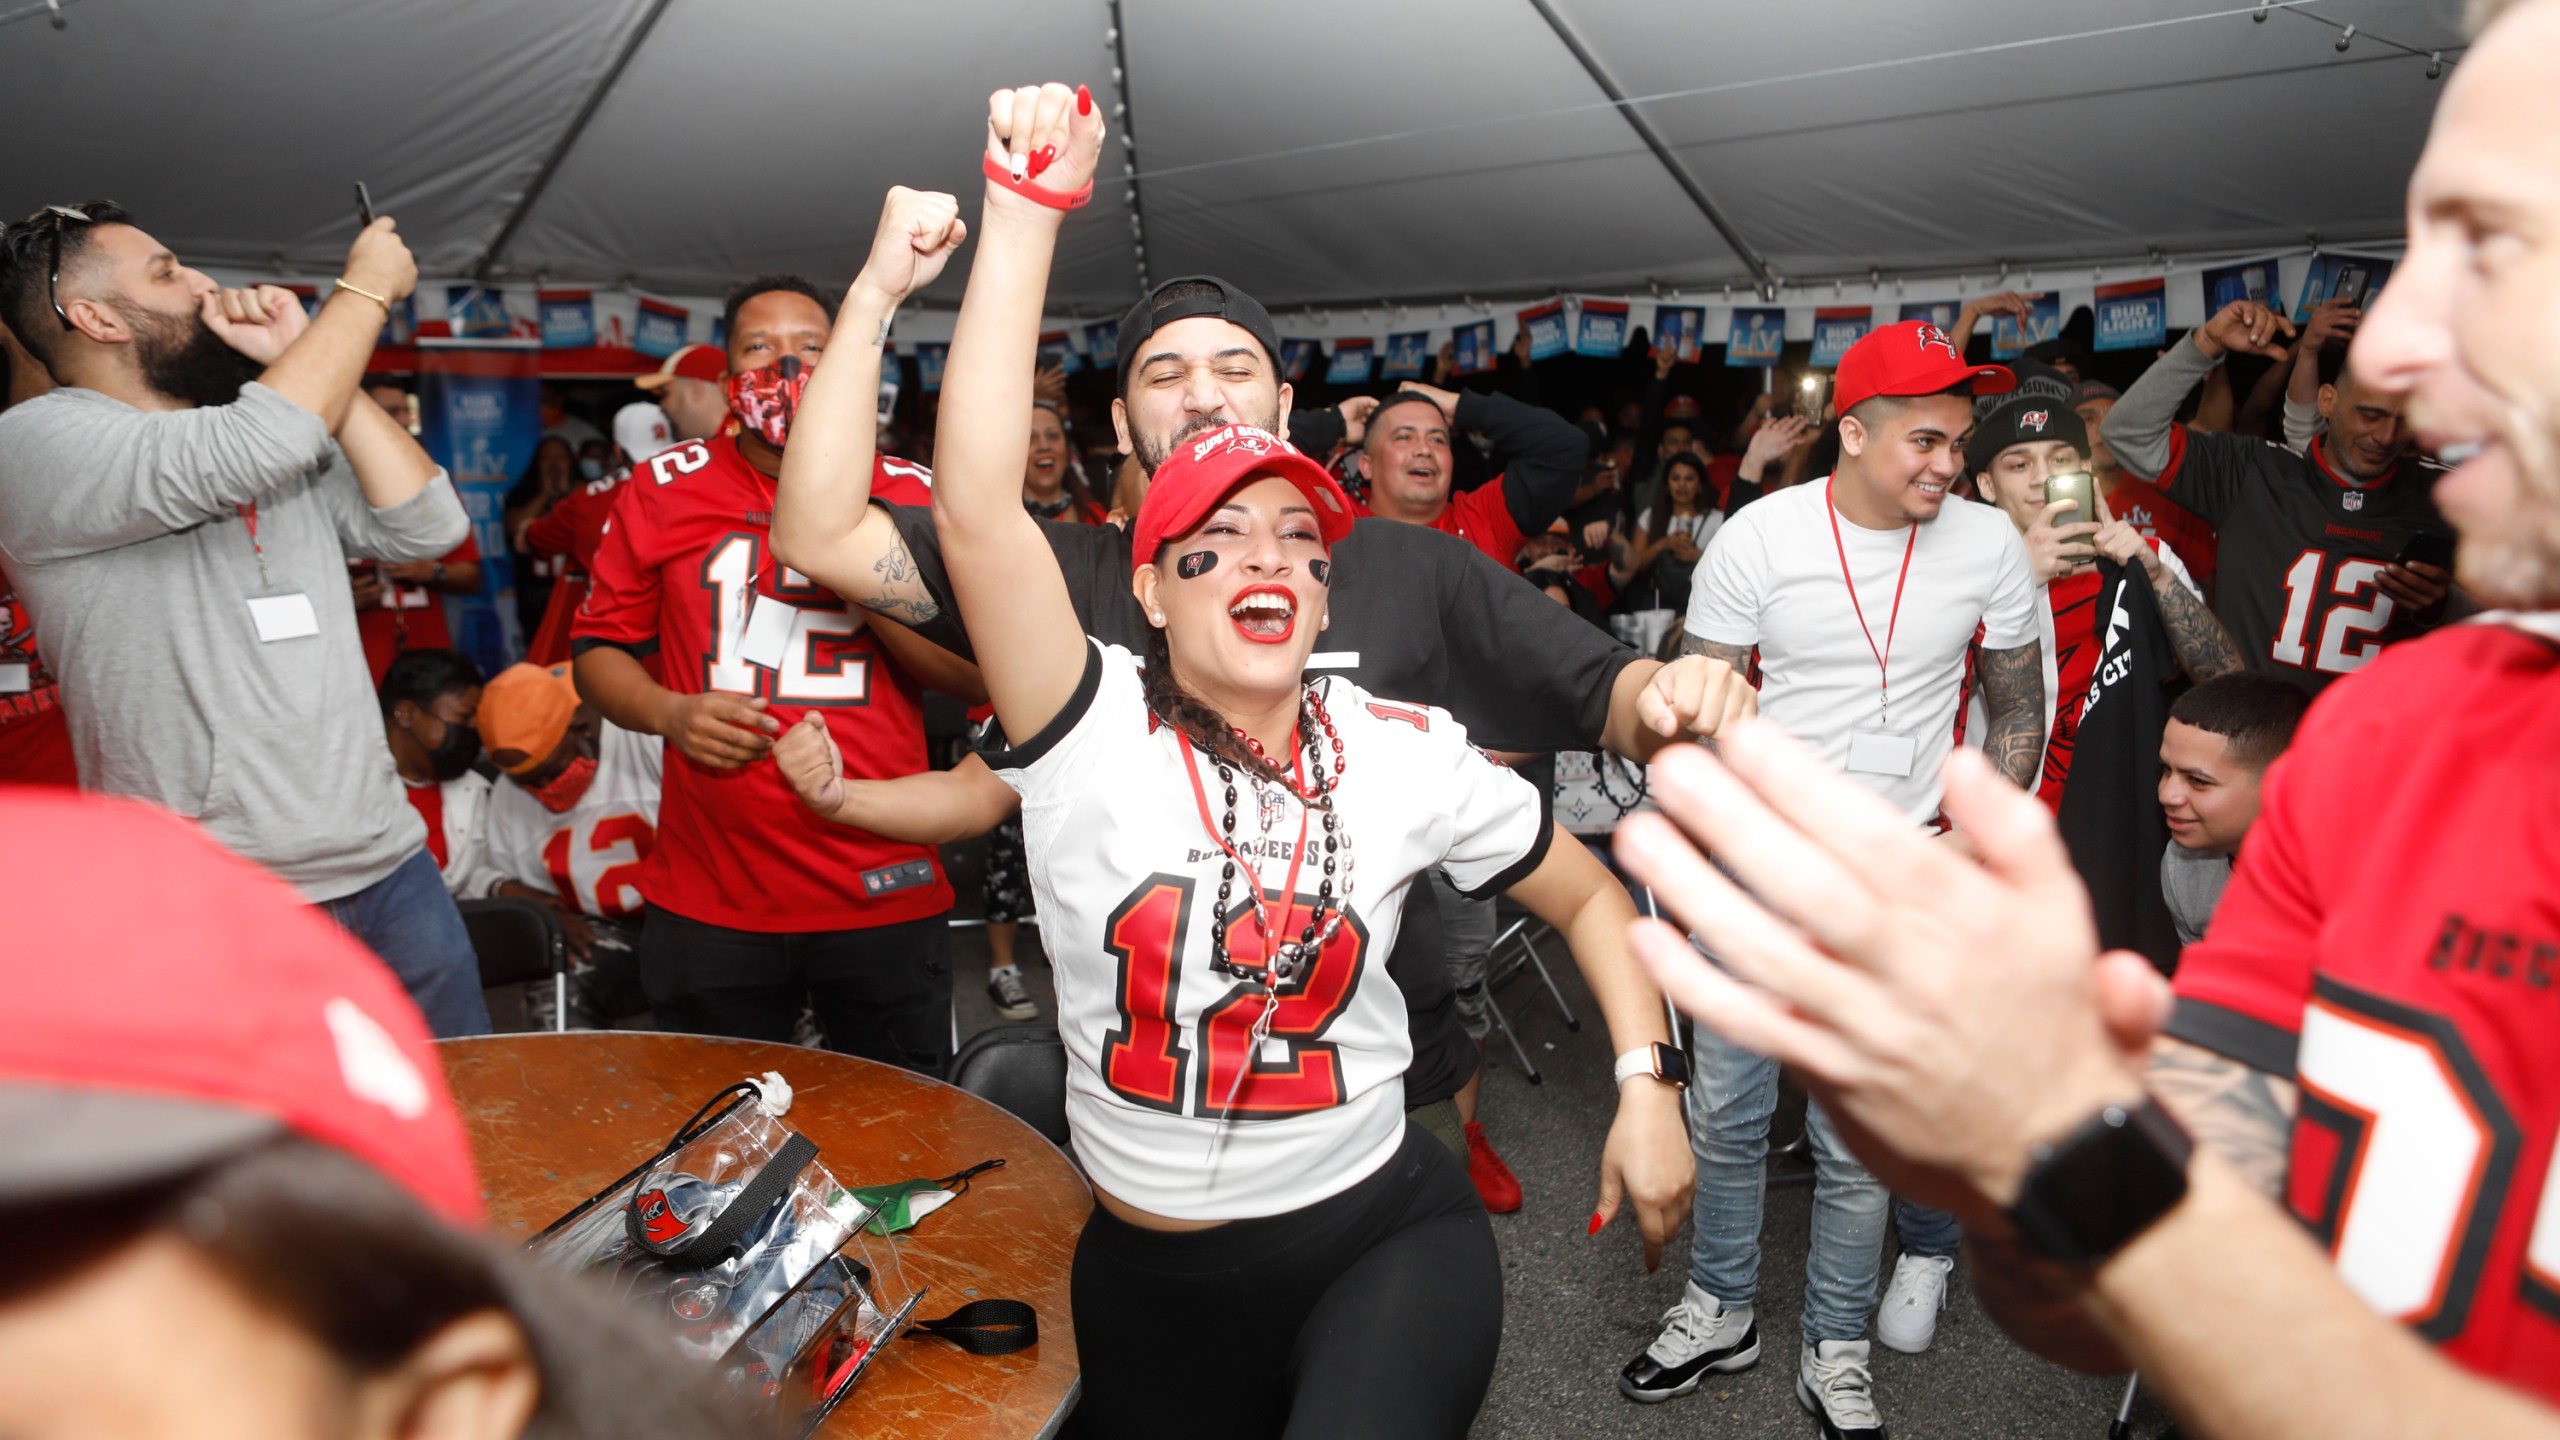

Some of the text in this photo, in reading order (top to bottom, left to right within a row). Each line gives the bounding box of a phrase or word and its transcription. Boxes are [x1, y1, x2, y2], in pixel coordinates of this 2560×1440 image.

[2102, 315, 2156, 332] LIGHT
[2109, 303, 2148, 319] BUD
[1583, 330, 1620, 342] LIGHT
[1590, 319, 1616, 331] BUD
[1733, 317, 1781, 353] LIV
[1826, 327, 1857, 338] BUD
[1819, 340, 1856, 351] LIGH
[2022, 380, 2065, 397] BOWL
[1193, 427, 1235, 462] SUPER
[1236, 425, 1283, 446] BOWL
[650, 440, 711, 486] 2
[701, 531, 873, 707] 12
[2271, 548, 2395, 675] 12
[541, 813, 656, 918] 12
[1100, 871, 1371, 1121] 12
